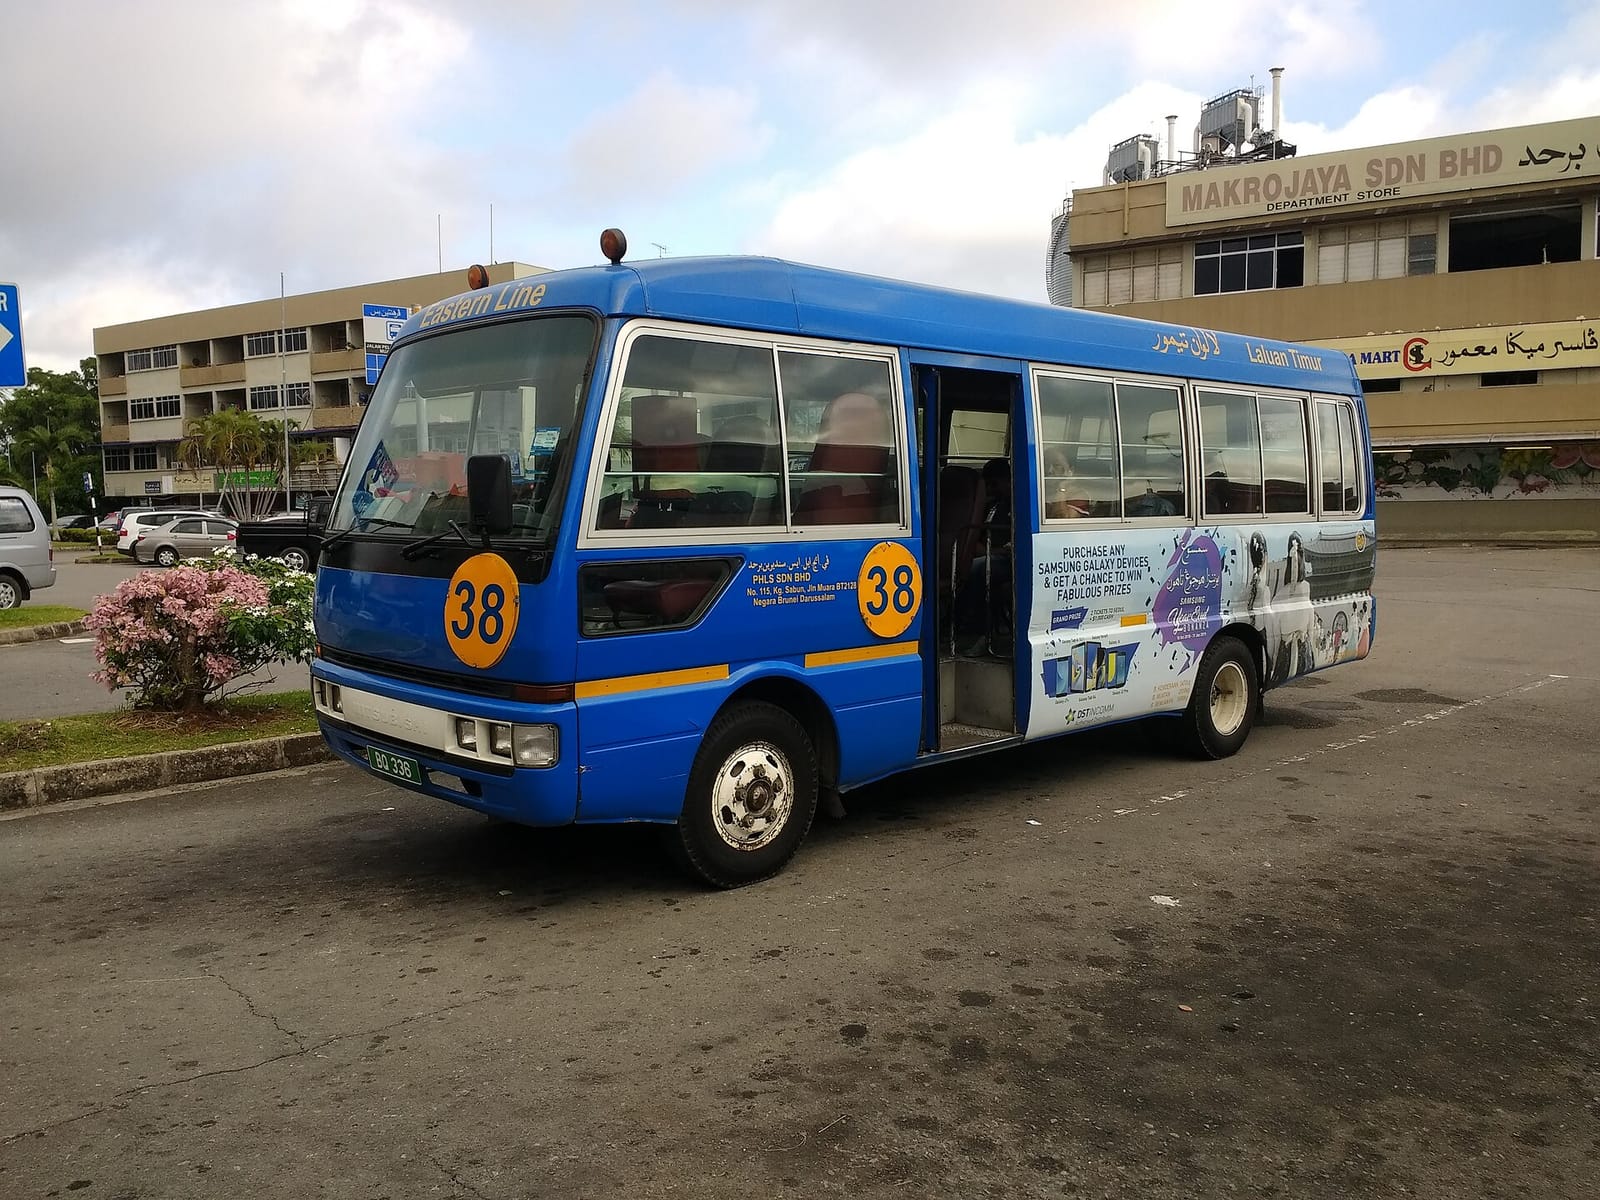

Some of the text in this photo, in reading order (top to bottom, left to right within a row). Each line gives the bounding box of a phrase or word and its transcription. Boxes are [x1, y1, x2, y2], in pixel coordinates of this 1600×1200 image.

[1181, 143, 1503, 213] MAKROJAYA SDN BHD
[1266, 186, 1400, 212] DEPARTMENT STORE
[420, 282, 547, 328] Eastern Line
[1245, 342, 1323, 372] Laluan Timur
[1360, 350, 1400, 365] MART
[1063, 544, 1125, 559] PURCHASE ANY
[1038, 556, 1149, 575] SAMSUNG GALAXY DEVICES
[752, 572, 811, 585] PHLS SDN BHD
[1044, 569, 1142, 589] & GET A CHANCE TO WIN
[747, 588, 758, 596] No.
[773, 586, 784, 595] Kg.
[785, 585, 806, 594] Sabun,
[817, 583, 835, 592] Muara
[866, 564, 915, 616] 38
[1057, 583, 1131, 602] FABULOUS PRIZES
[753, 593, 836, 608] Negara Brunei Darussalam
[1179, 595, 1206, 605] SAMSUNG
[451, 579, 506, 645] 38
[1052, 612, 1082, 624] GRAND PRIZE
[390, 757, 412, 778] 336
